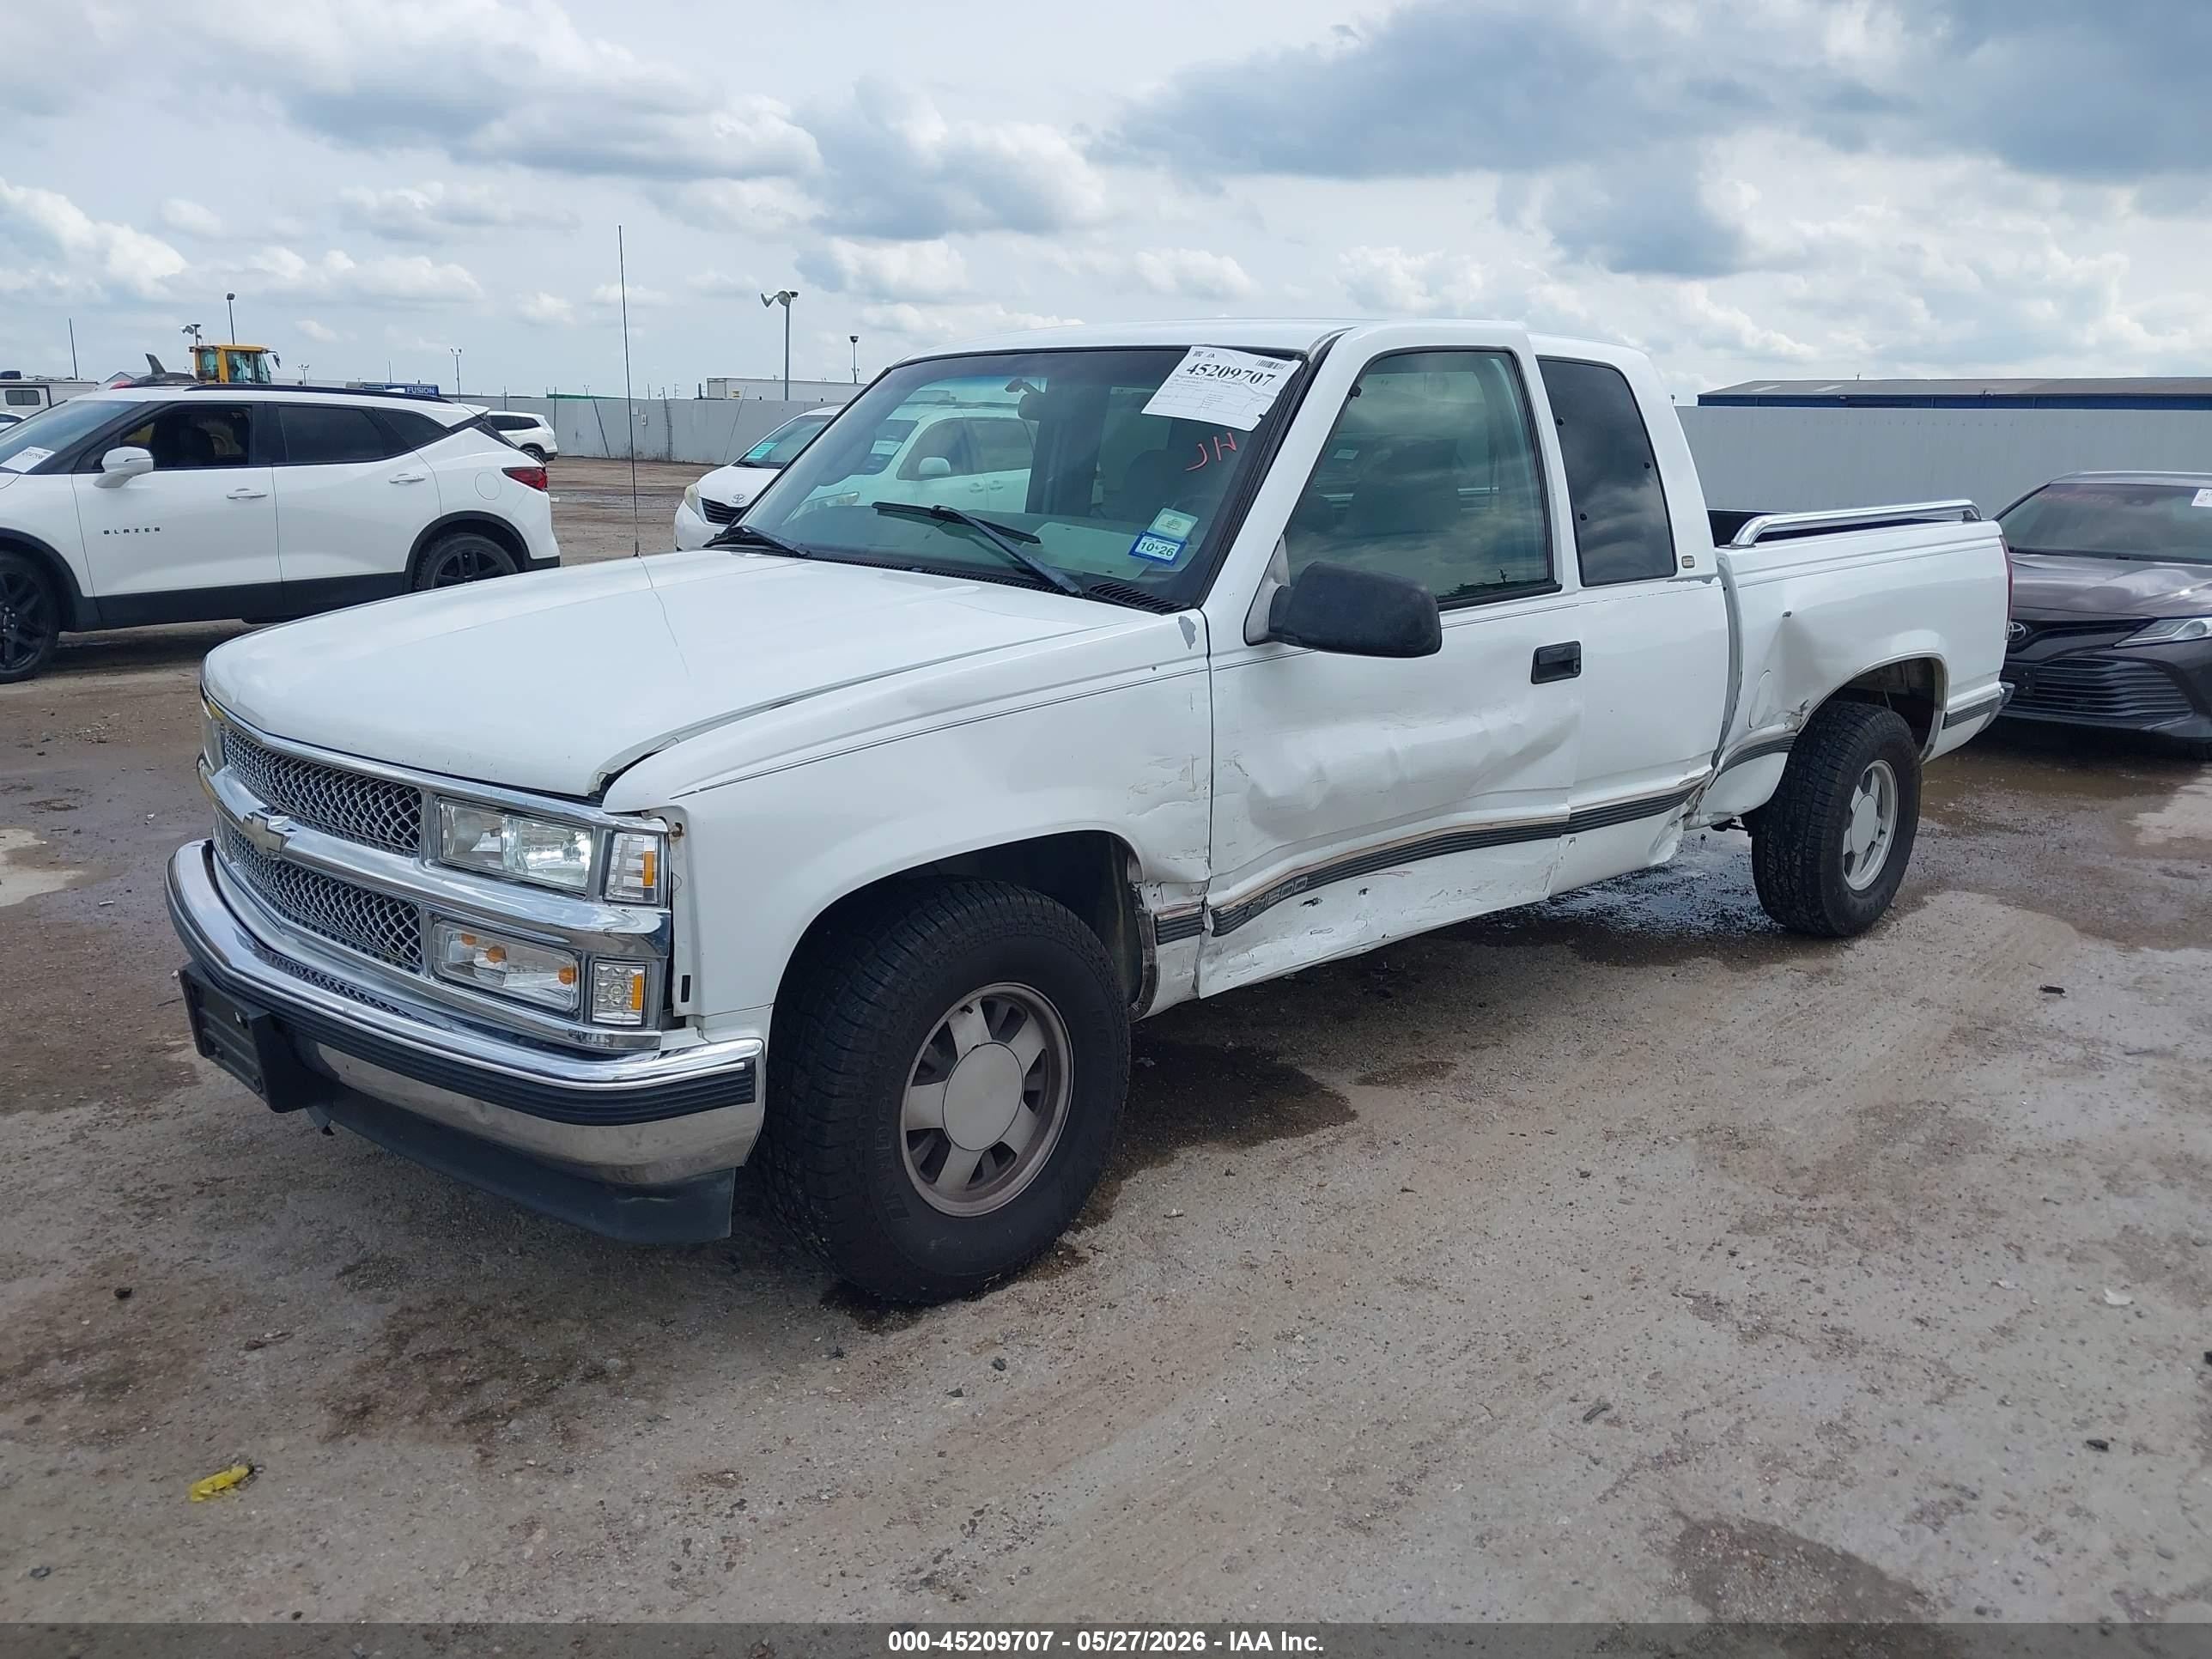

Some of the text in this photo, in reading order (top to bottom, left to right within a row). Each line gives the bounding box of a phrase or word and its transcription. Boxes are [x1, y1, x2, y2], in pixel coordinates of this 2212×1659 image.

[1186, 362, 1277, 386] 45209707
[407, 386, 435, 395] FUSION
[103, 526, 161, 535] BLAZER
[1140, 541, 1155, 552] 10
[1158, 545, 1176, 556] 26
